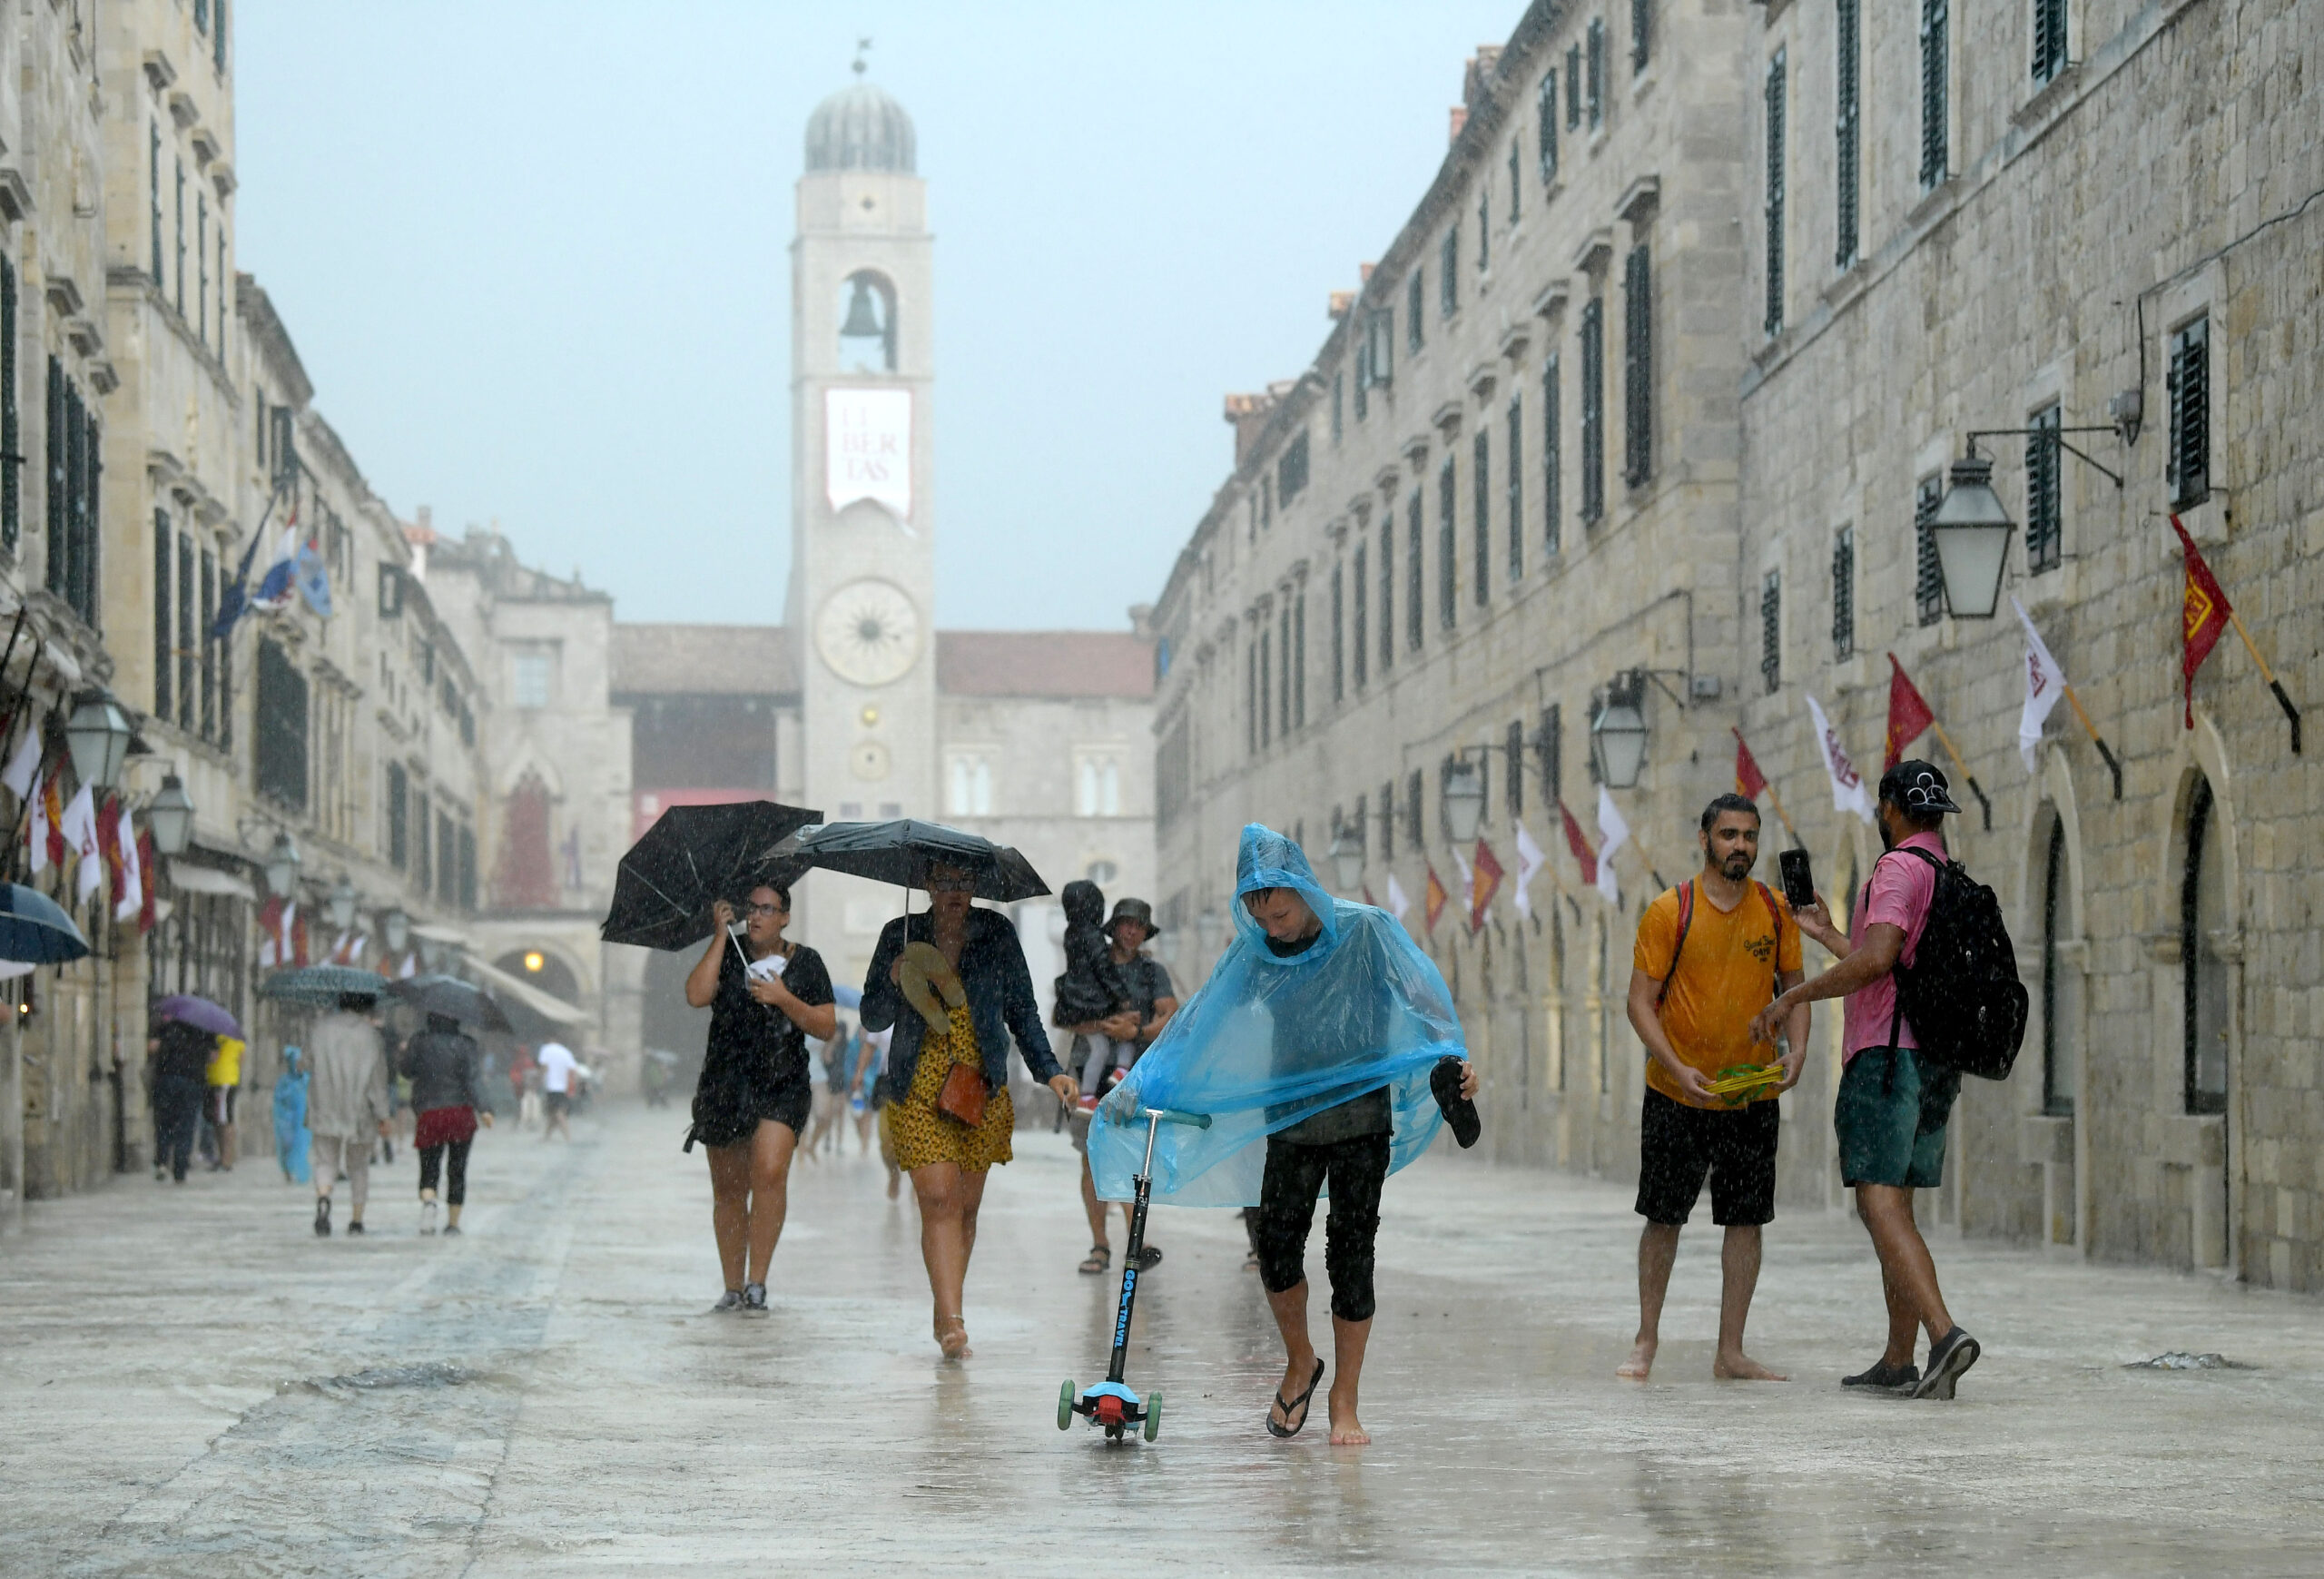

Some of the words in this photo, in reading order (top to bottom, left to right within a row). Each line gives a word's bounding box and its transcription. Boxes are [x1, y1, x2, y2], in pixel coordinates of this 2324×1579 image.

[842, 431, 900, 456] BER
[1124, 1269, 1136, 1291] GO
[1114, 1308, 1128, 1348] TRAVEL
